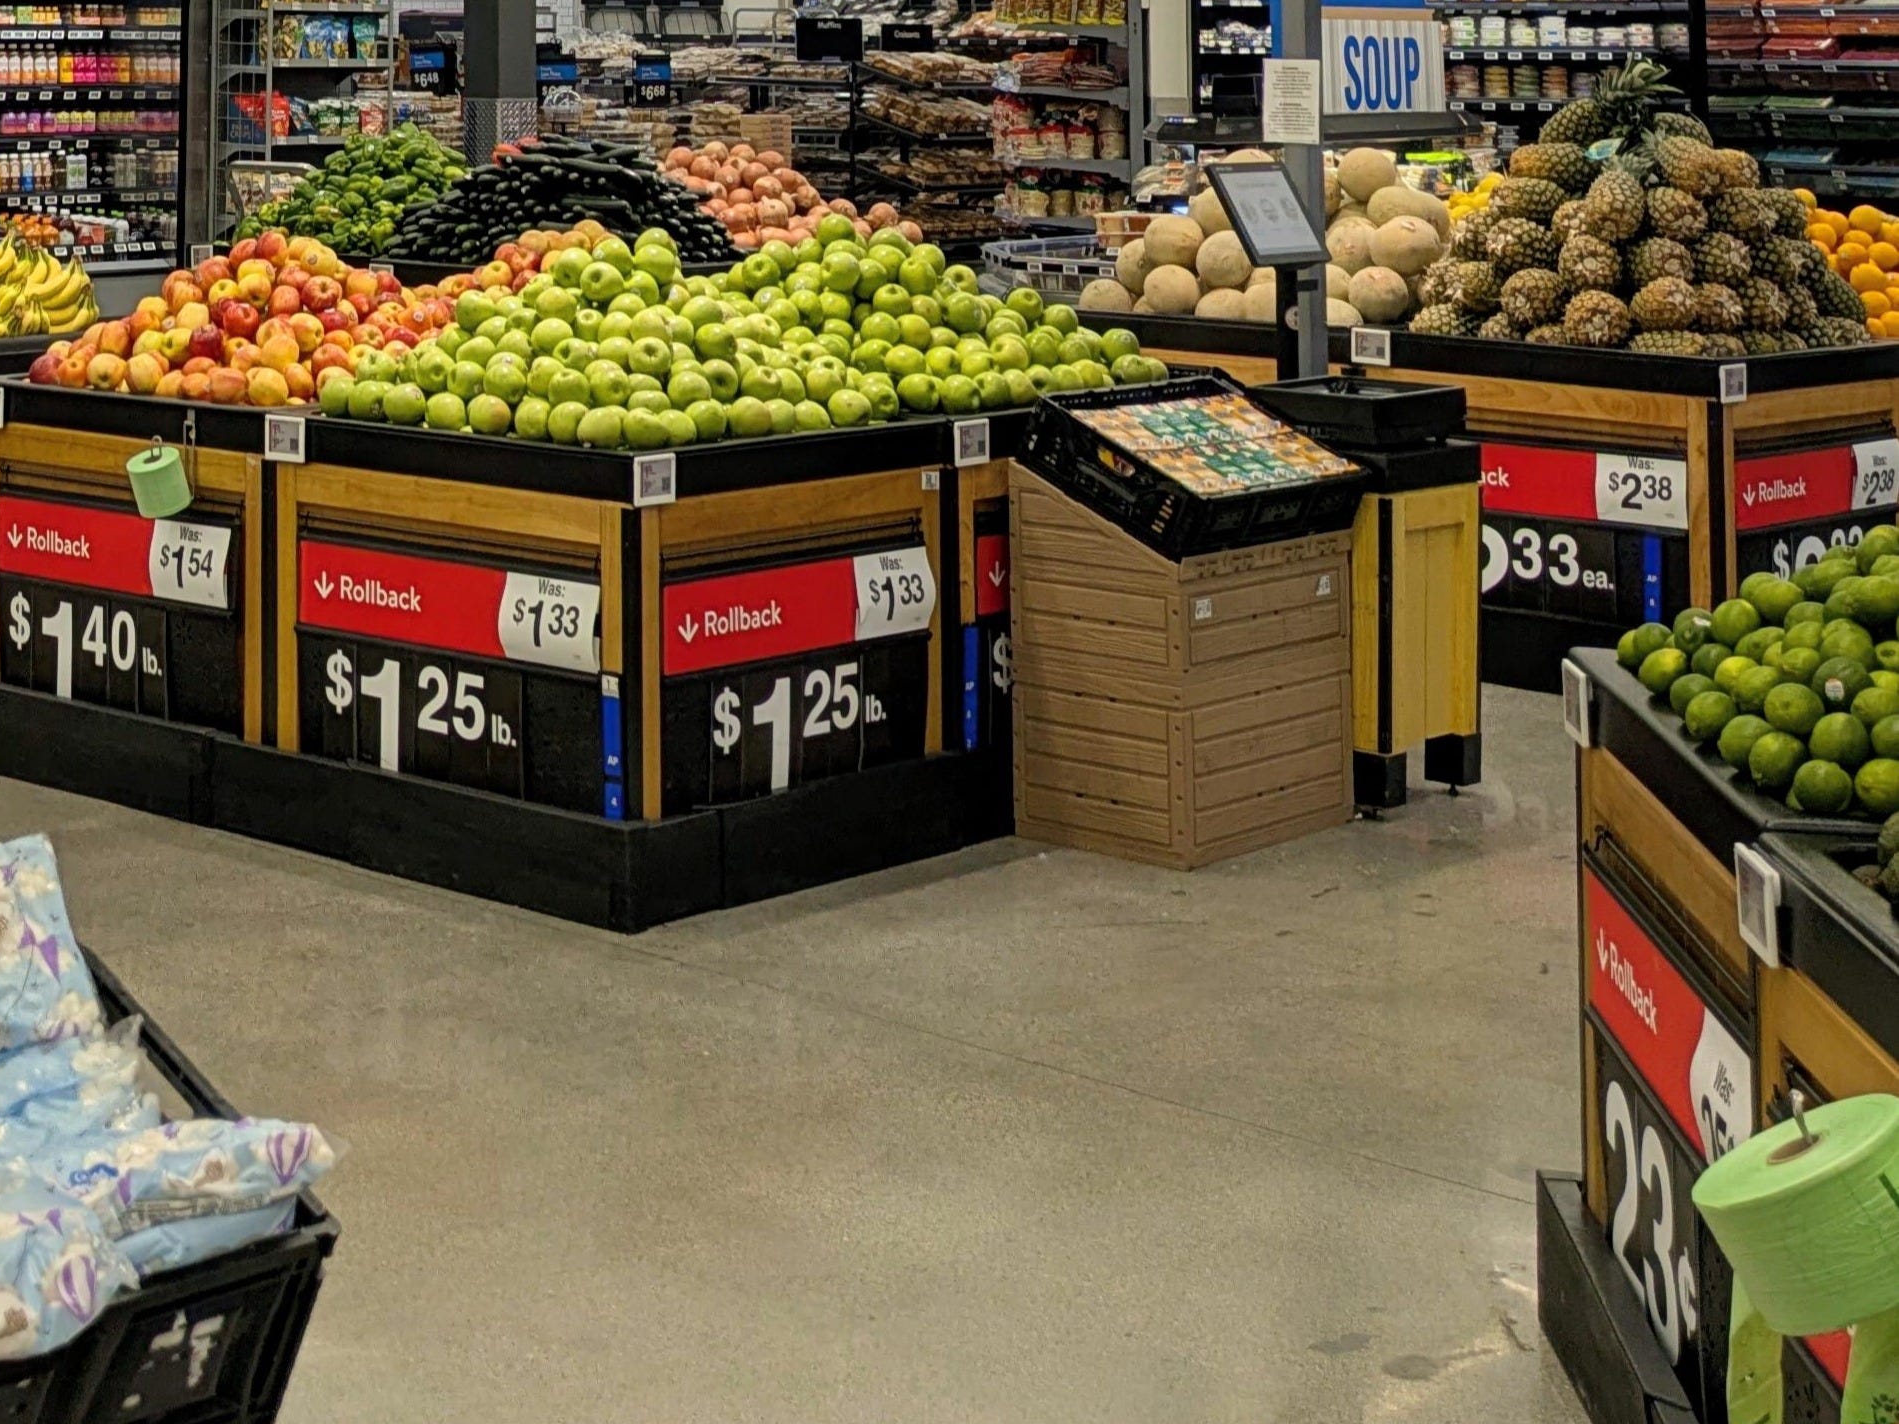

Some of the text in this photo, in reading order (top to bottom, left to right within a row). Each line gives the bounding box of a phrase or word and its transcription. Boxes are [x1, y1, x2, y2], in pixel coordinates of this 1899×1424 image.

[817, 21, 842, 30] Muffins
[1344, 35, 1420, 111] SOUP
[1627, 455, 1654, 470] Was:
[1758, 476, 1806, 502] Rollback
[26, 526, 90, 560] Rollback
[179, 525, 202, 543] Was:
[879, 556, 904, 572] Was:
[340, 574, 422, 613] Rollback
[538, 578, 566, 598] Was:
[1582, 569, 1614, 590] ea.
[704, 600, 782, 638] Rollback
[142, 647, 162, 676] lb.
[864, 694, 887, 724] lb.
[491, 714, 517, 748] lb.
[1608, 941, 1658, 1035] Rollback
[1714, 1060, 1735, 1108] Was:
